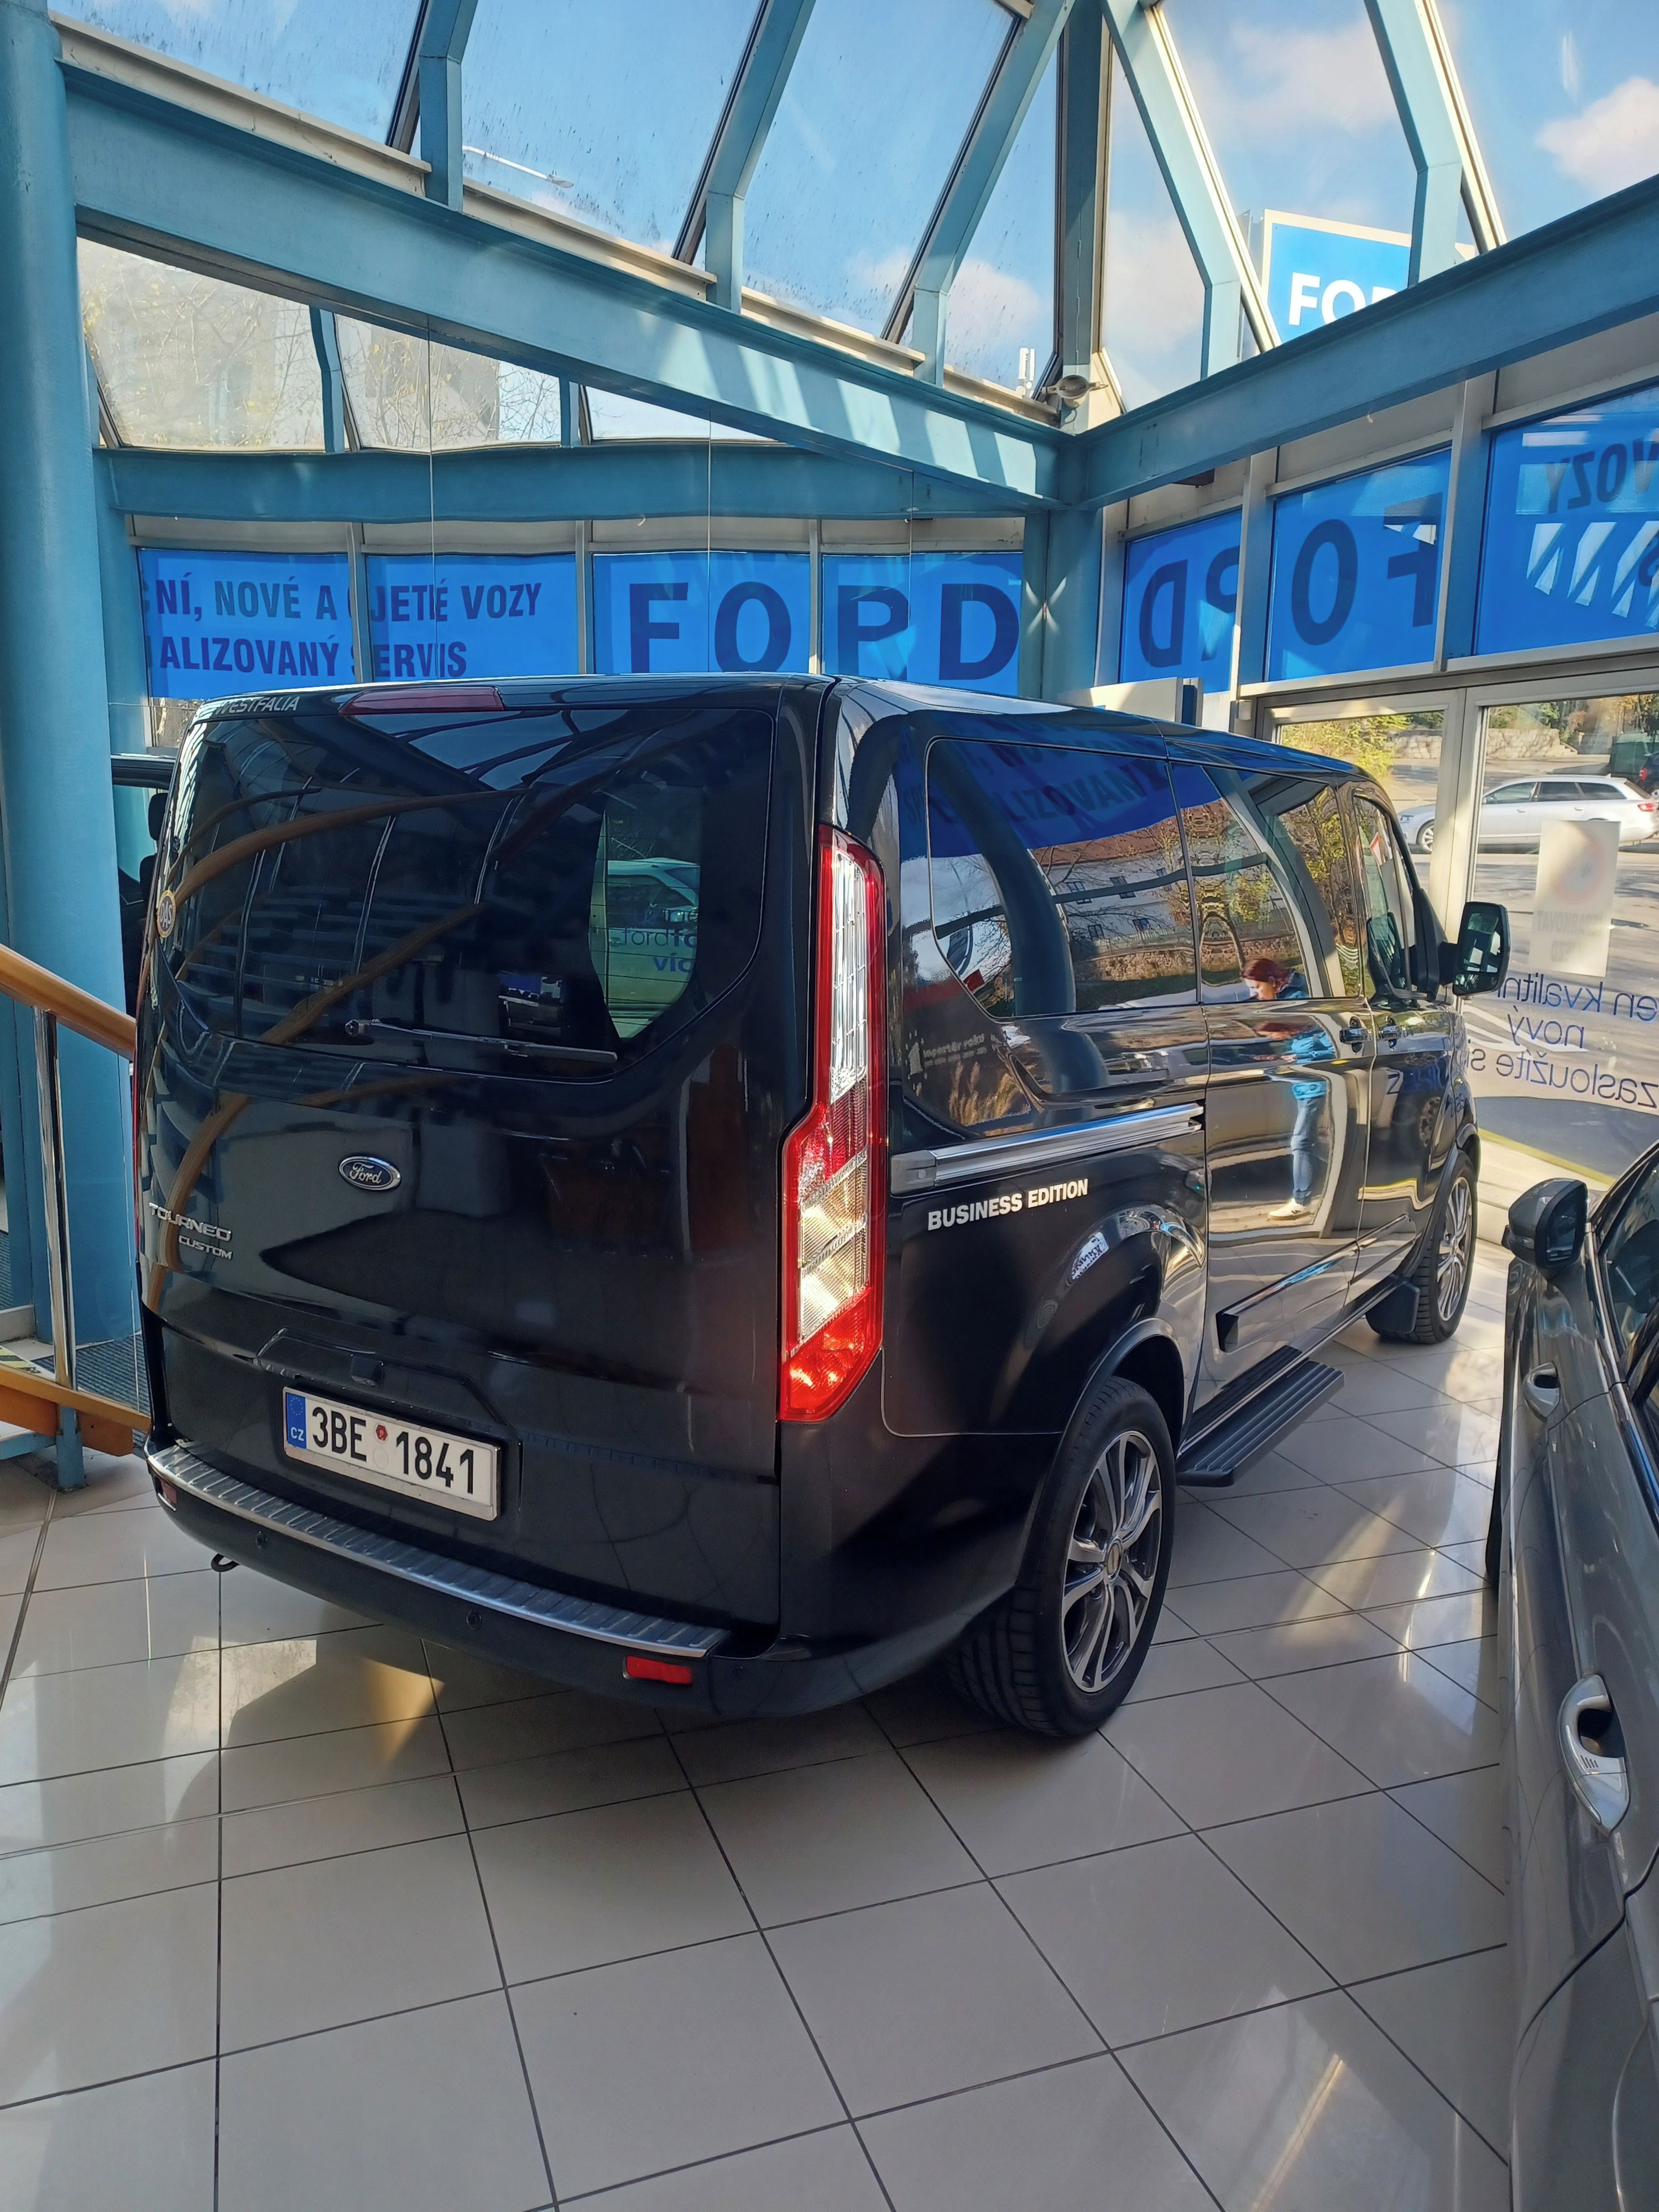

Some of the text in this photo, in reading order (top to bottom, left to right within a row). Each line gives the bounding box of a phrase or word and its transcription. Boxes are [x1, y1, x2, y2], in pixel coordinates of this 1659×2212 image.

[1288, 272, 1397, 326] FO
[215, 576, 301, 618] NOVÉ
[316, 585, 337, 619] A
[347, 578, 448, 623] JETÉ
[462, 583, 542, 619] VOZY
[351, 640, 467, 678] ERVIS
[215, 695, 300, 716] WESTFALIA
[349, 1162, 382, 1185] Ford
[148, 1202, 232, 1242] TOURNEO
[927, 1178, 1089, 1231] BUSINESS EDITION
[179, 1235, 232, 1260] CUSTOM
[291, 1428, 304, 1442] CZ
[311, 1407, 474, 1494] 3BE 1841
